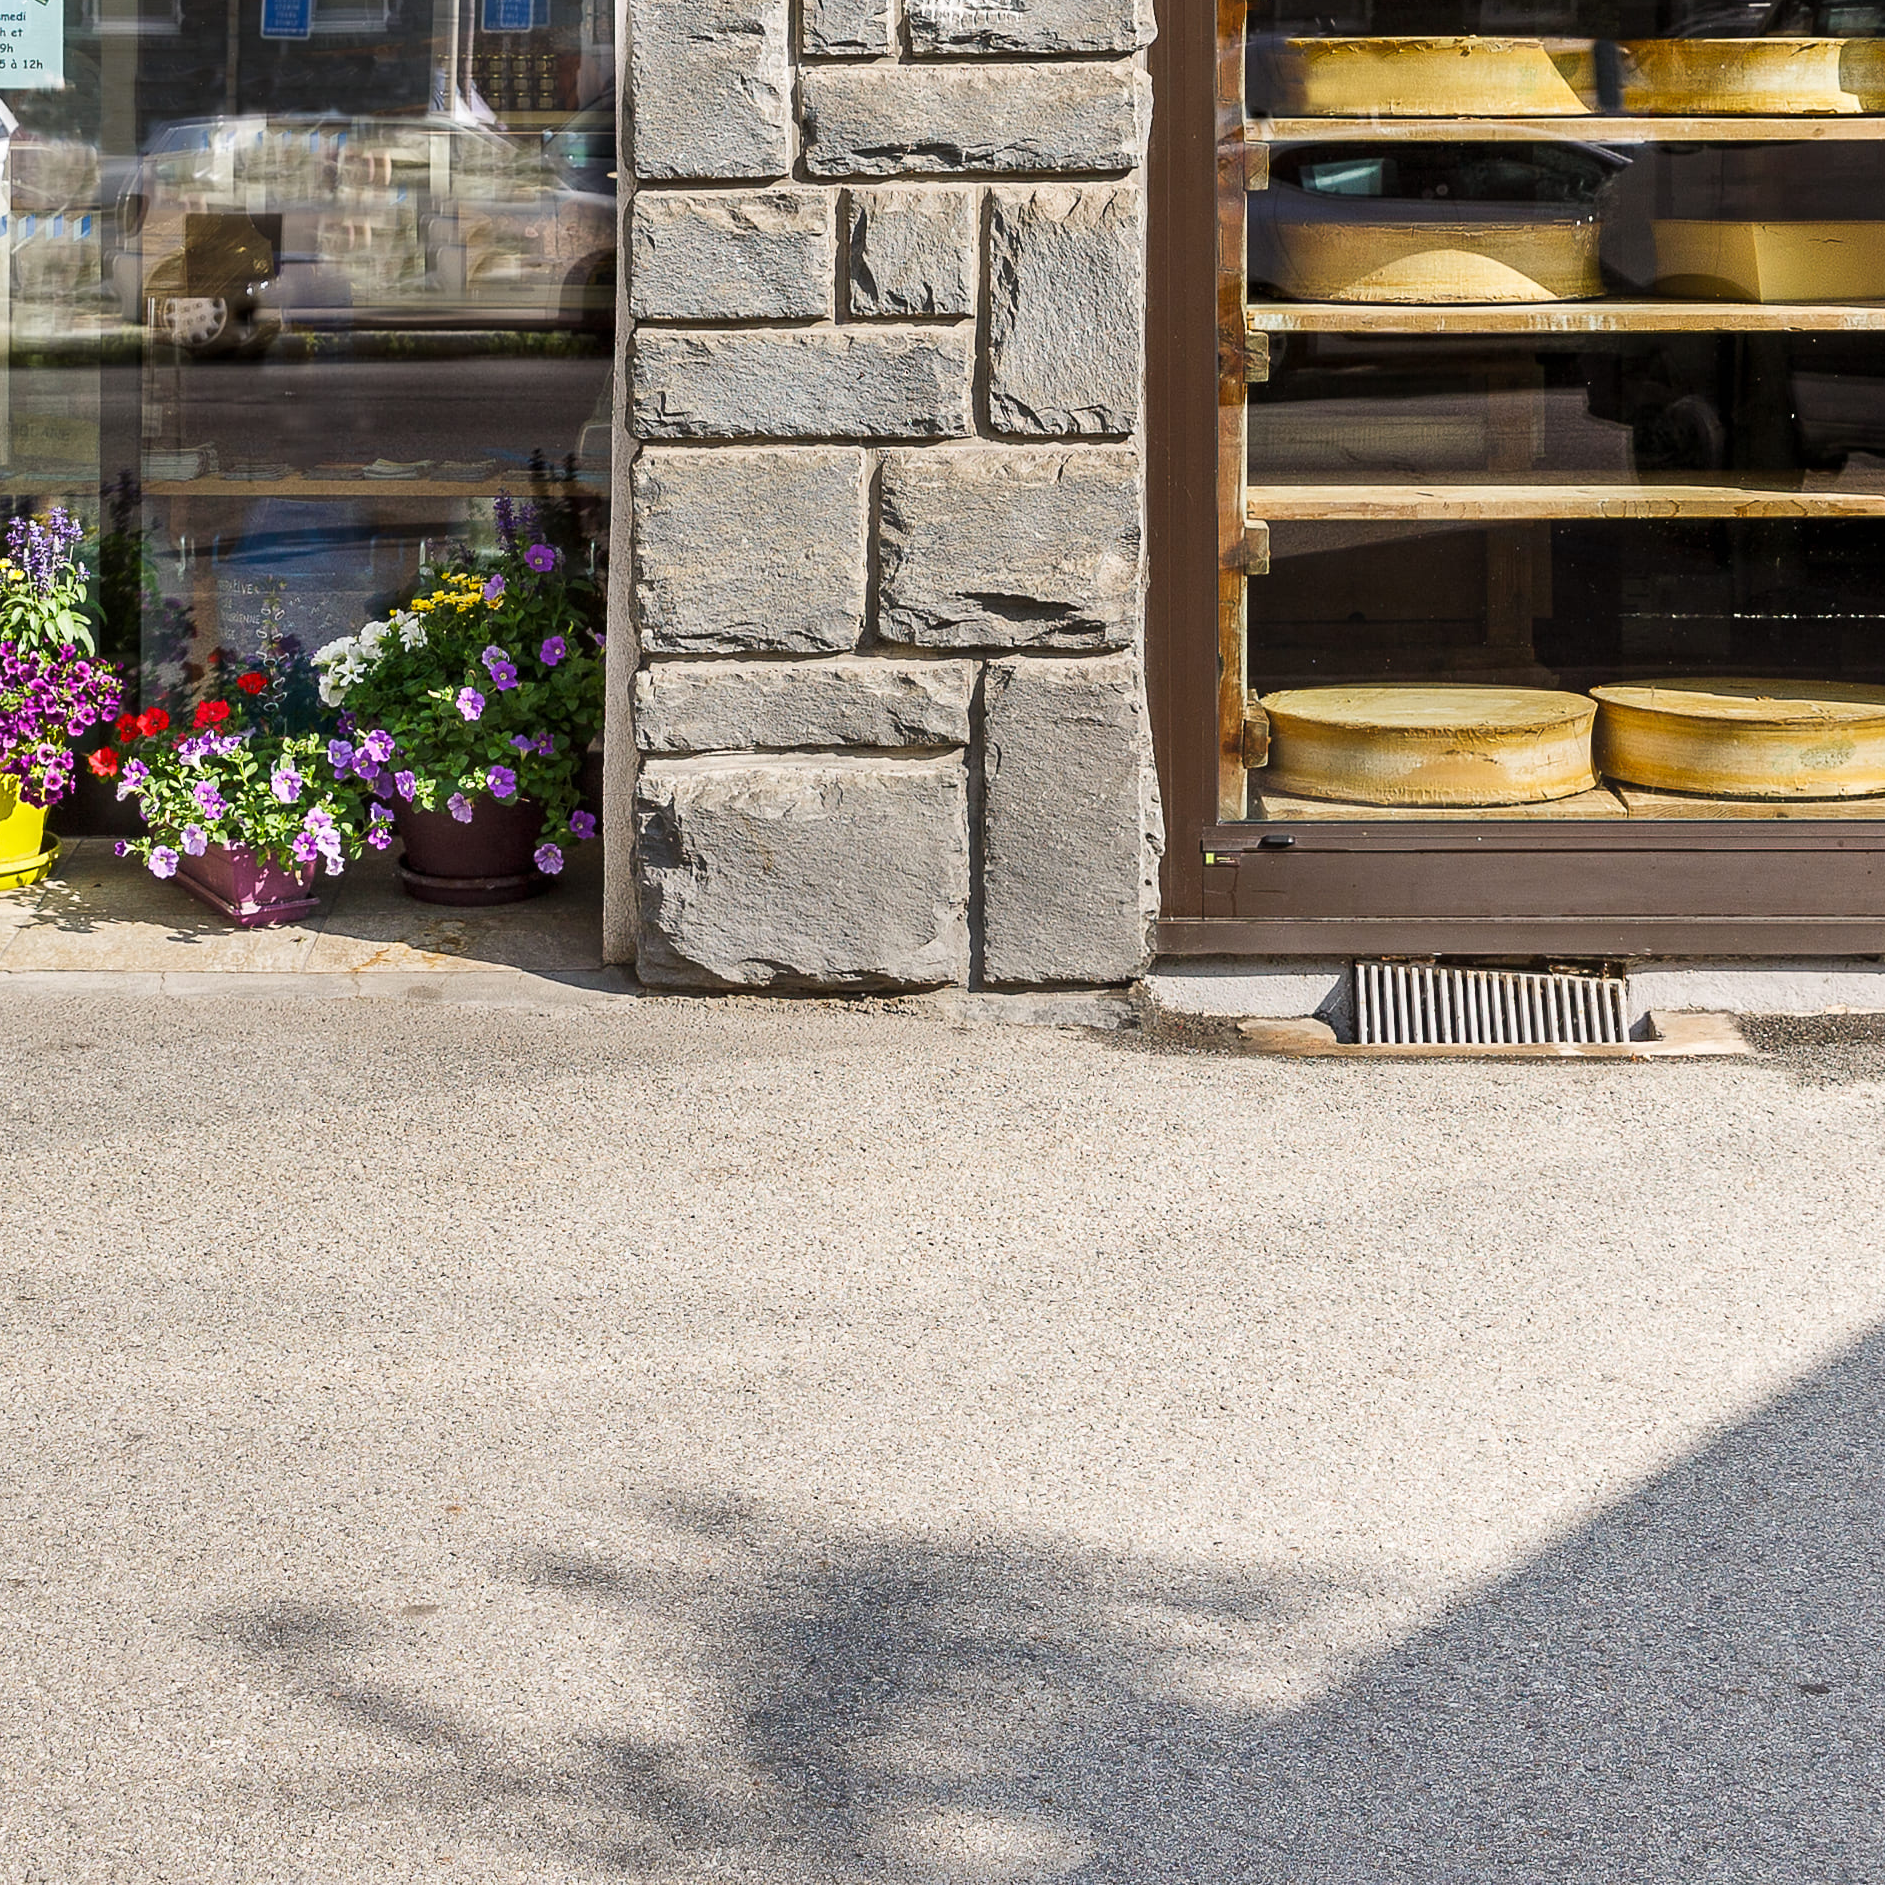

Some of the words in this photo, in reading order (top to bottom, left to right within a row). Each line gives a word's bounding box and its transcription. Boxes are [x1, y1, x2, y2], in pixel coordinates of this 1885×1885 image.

[11, 28, 23, 37] et
[11, 59, 17, 69] à
[24, 59, 43, 69] 12h
